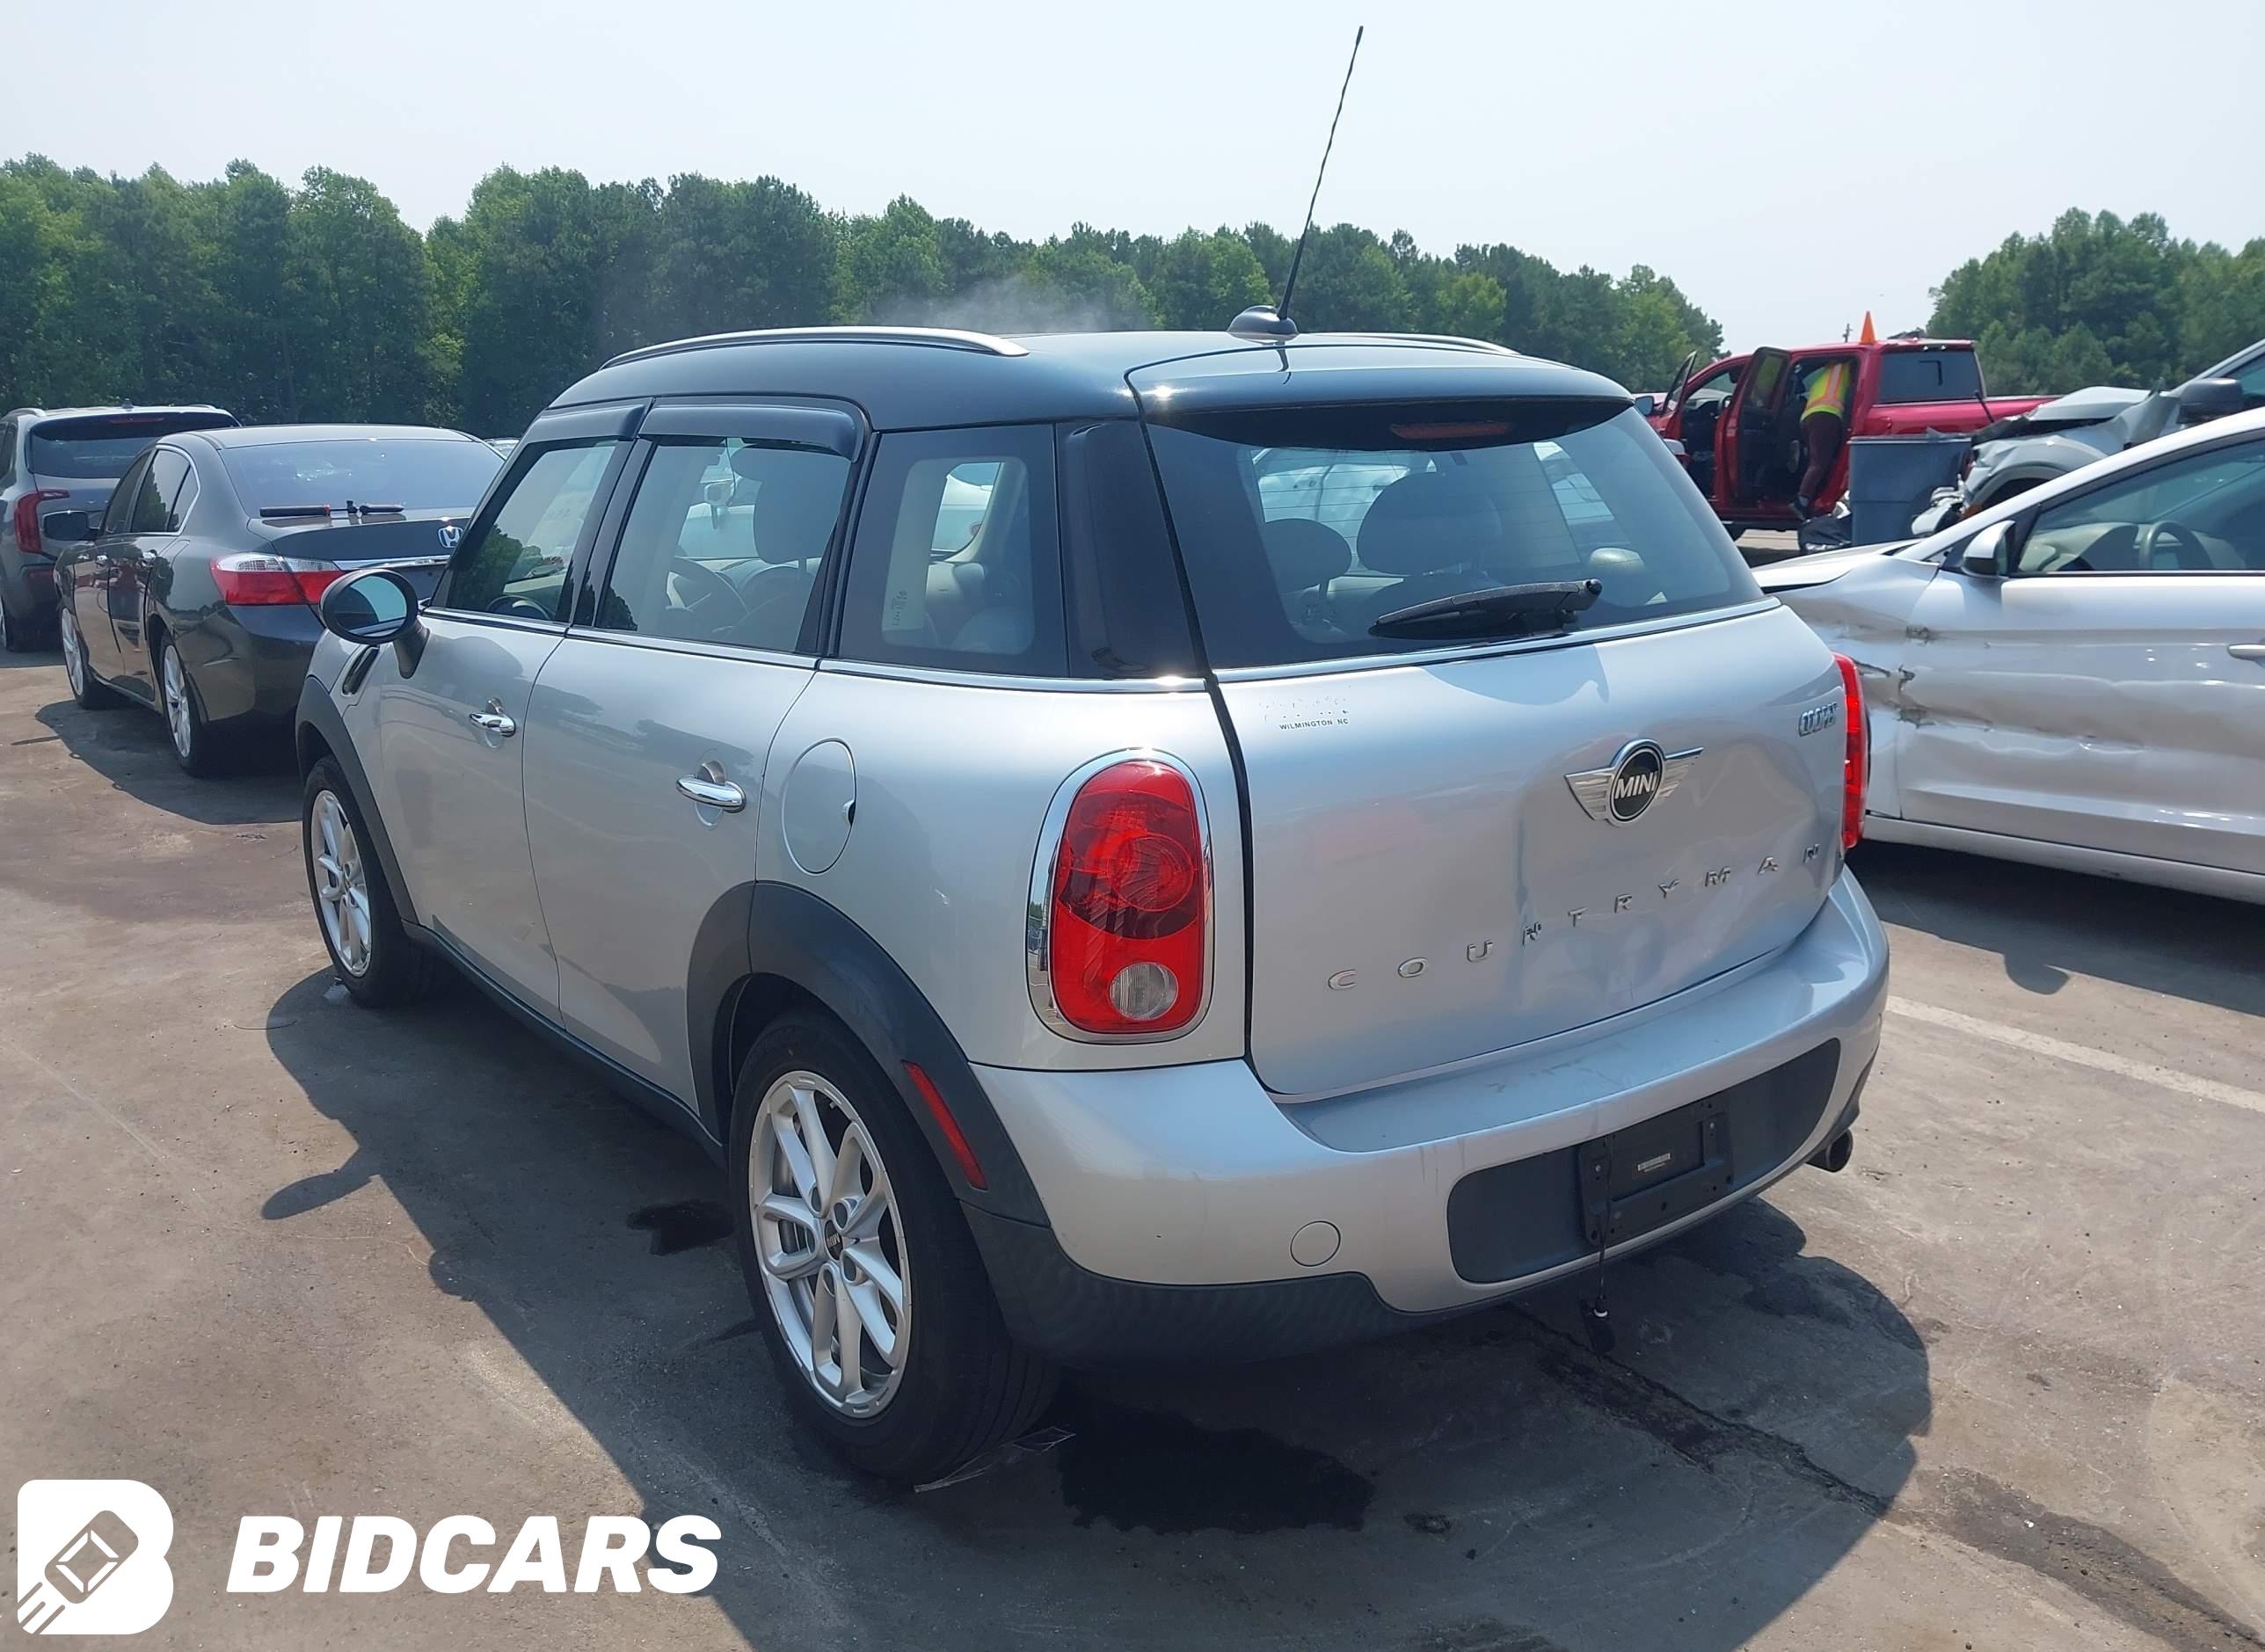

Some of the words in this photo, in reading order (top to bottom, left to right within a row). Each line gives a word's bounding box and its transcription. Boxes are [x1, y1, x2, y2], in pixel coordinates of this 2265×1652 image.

[1279, 719, 1333, 730] WILMINGTON
[1614, 770, 1658, 800] MINI
[1327, 844, 1820, 991] COUNTRYMAN
